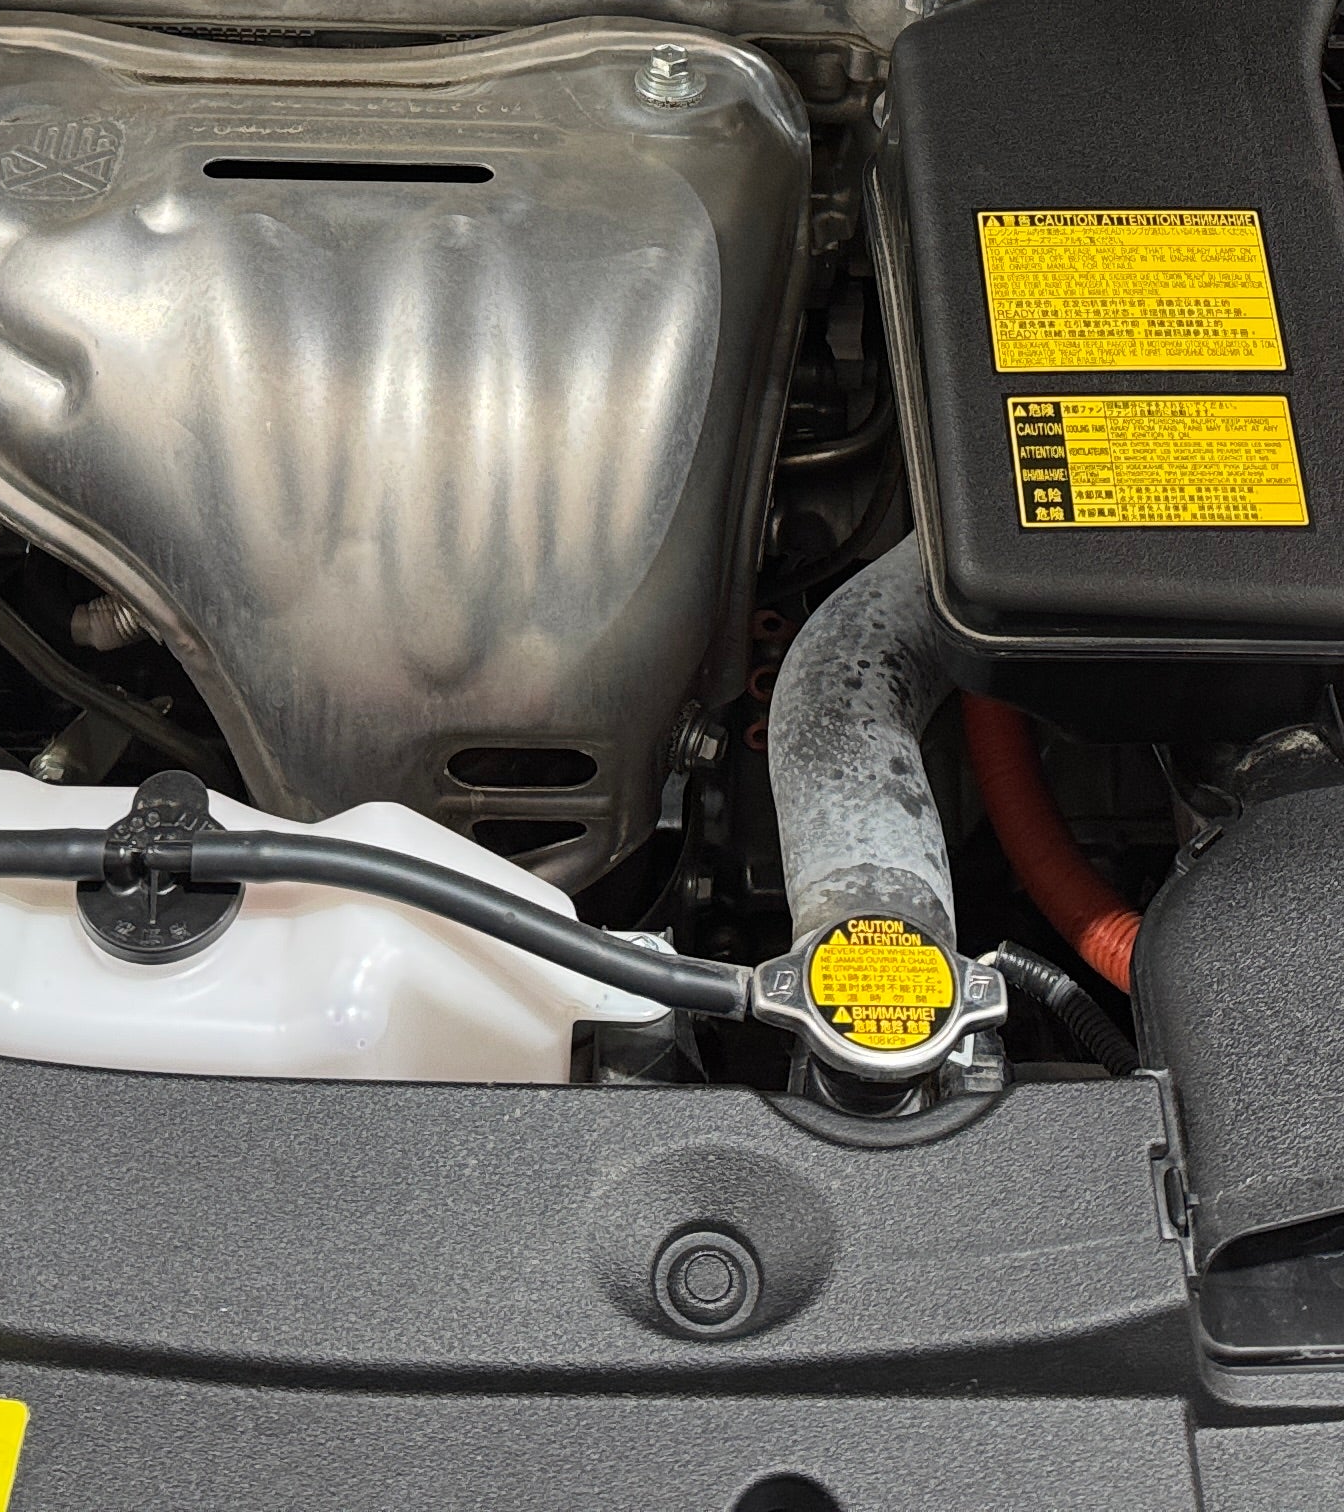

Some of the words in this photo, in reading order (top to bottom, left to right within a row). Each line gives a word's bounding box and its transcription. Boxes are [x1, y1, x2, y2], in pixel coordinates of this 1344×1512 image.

[1034, 214, 1098, 226] CAUTION
[1101, 214, 1181, 226] ATTENTION
[1183, 214, 1253, 226] ВНИМАНИЕ
[1016, 422, 1063, 436] CAUTION
[1020, 445, 1066, 460] ATTENTION
[847, 919, 904, 934] CAUTION
[850, 933, 922, 946] ATTENTION
[824, 948, 856, 956] NEVER
[858, 948, 885, 956] OPEN
[887, 948, 916, 956] WHEN
[918, 949, 938, 957] HOT
[820, 956, 833, 964] NE
[834, 956, 865, 964] JAMAIS
[907, 957, 938, 965] CHAUD
[852, 1006, 936, 1021] ВНИМАНИЕ!
